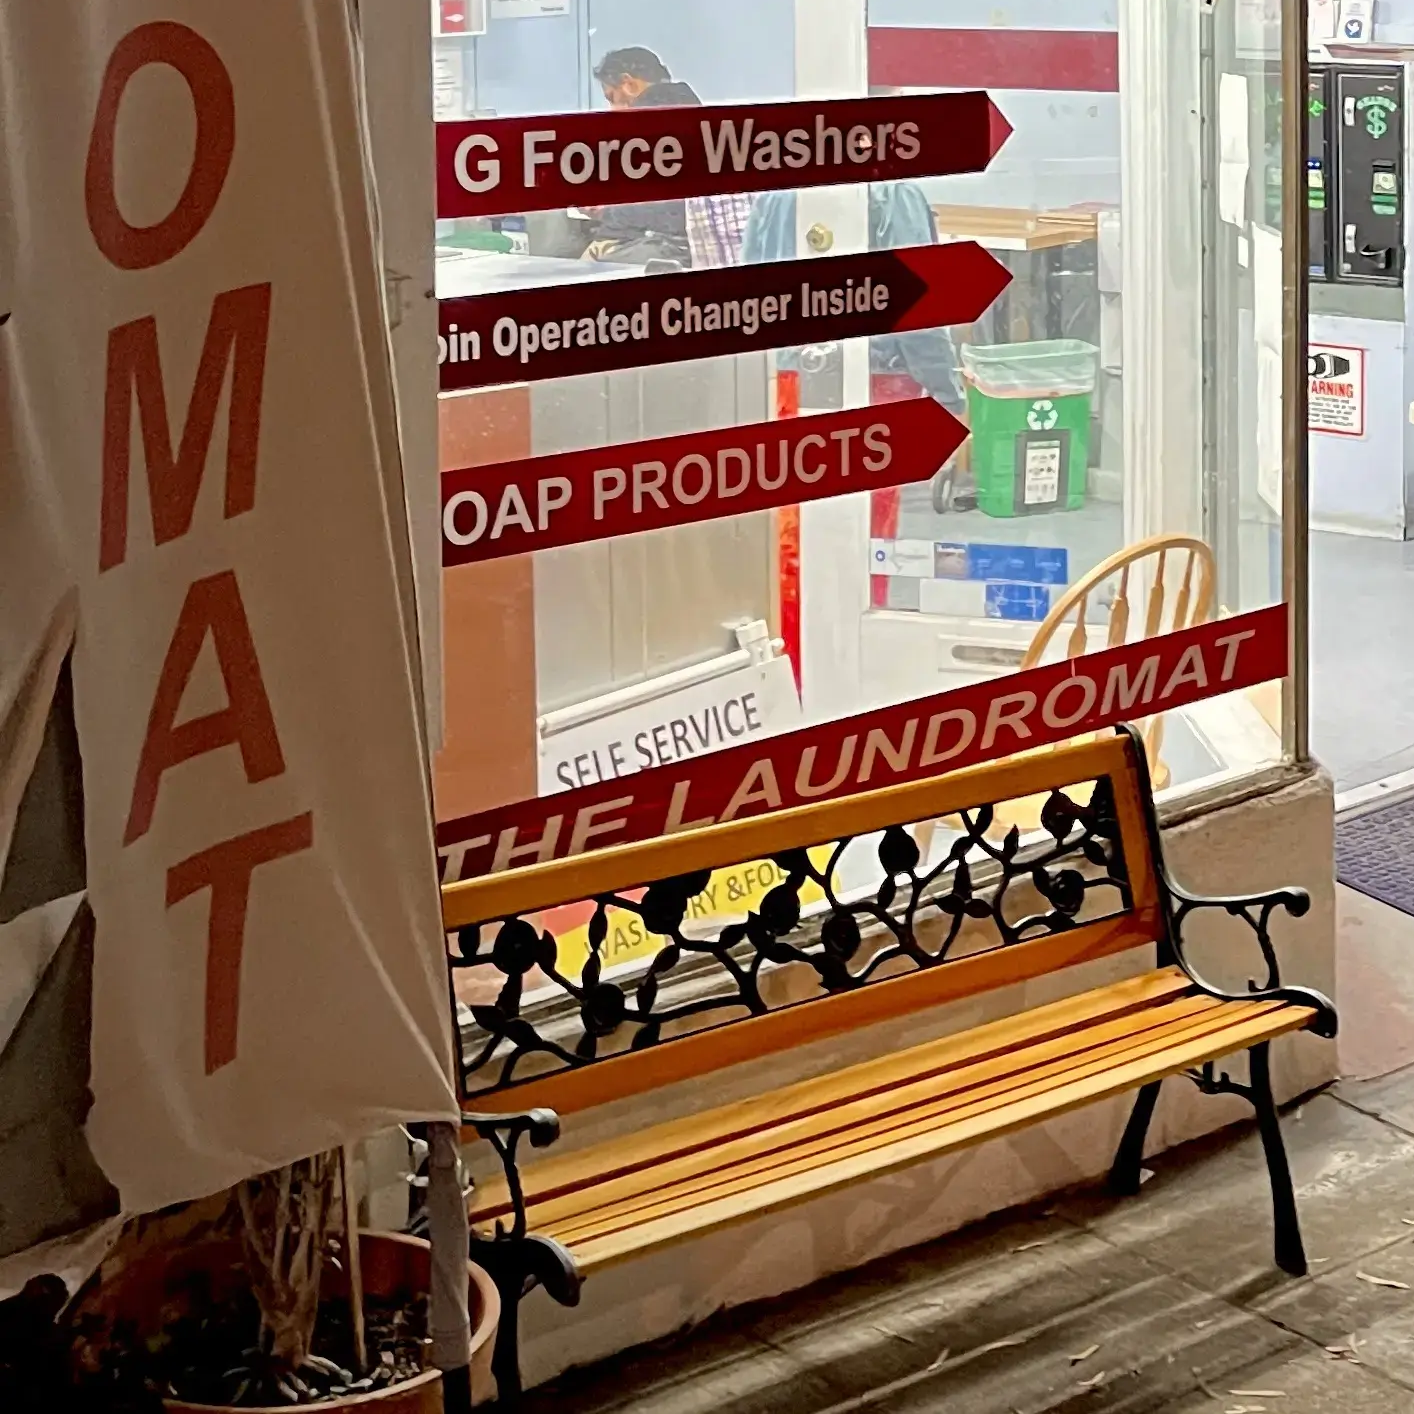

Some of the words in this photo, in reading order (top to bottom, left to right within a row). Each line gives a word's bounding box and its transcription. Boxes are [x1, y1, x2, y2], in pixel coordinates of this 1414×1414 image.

[454, 133, 500, 193] G
[523, 129, 684, 188] Force
[700, 114, 921, 174] Washers
[437, 324, 481, 365] oin
[492, 301, 649, 364] Operated
[661, 292, 792, 336] Changer
[801, 276, 890, 318] Inside
[1308, 379, 1354, 398] ARNING
[442, 476, 573, 546] OAP
[593, 422, 893, 520] PRODUCTS
[438, 794, 635, 884] THE
[662, 630, 1256, 836] LAUNDROMAT
[556, 741, 625, 789] SELF
[634, 692, 762, 770] SERVICE
[584, 919, 650, 960] WAS
[685, 886, 718, 919] RY
